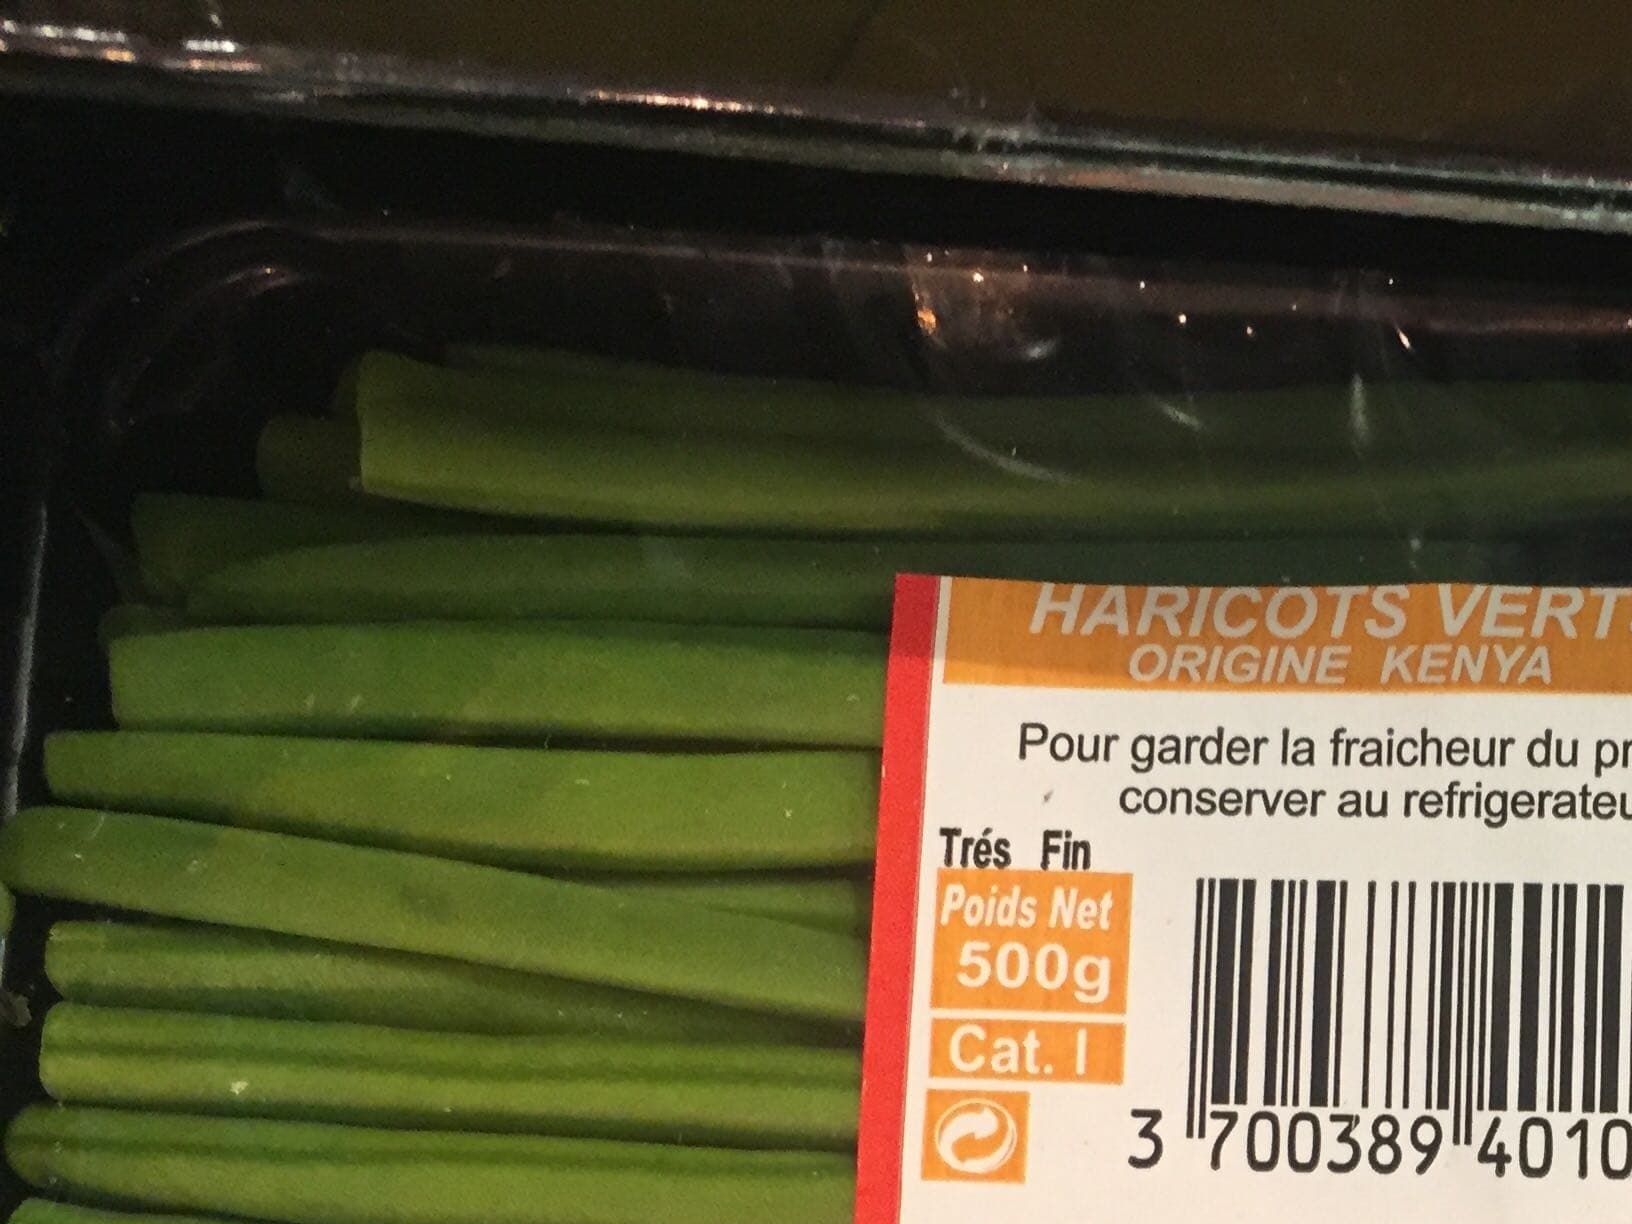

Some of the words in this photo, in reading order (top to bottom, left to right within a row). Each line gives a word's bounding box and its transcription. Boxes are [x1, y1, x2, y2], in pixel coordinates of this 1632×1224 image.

[1029, 583, 1411, 640] HARICOTS
[1128, 643, 1352, 684] ORIGINE
[1380, 644, 1552, 685] KENYA
[1018, 722, 1119, 763] Pour
[1130, 726, 1268, 774] garder
[1281, 728, 1315, 767] la
[1331, 727, 1516, 768] fraicheur
[1526, 729, 1579, 768] du
[1118, 786, 1326, 818] conserver
[1337, 788, 1389, 819] au
[939, 827, 1013, 870] Trés
[1040, 829, 1092, 871] Fin
[940, 883, 1037, 929] Poids
[1048, 886, 1113, 931] Net
[956, 940, 1111, 1005] 500g
[948, 1024, 1054, 1076] Cat.
[1127, 1108, 1164, 1169] 3
[1208, 1110, 1445, 1175] 700389
